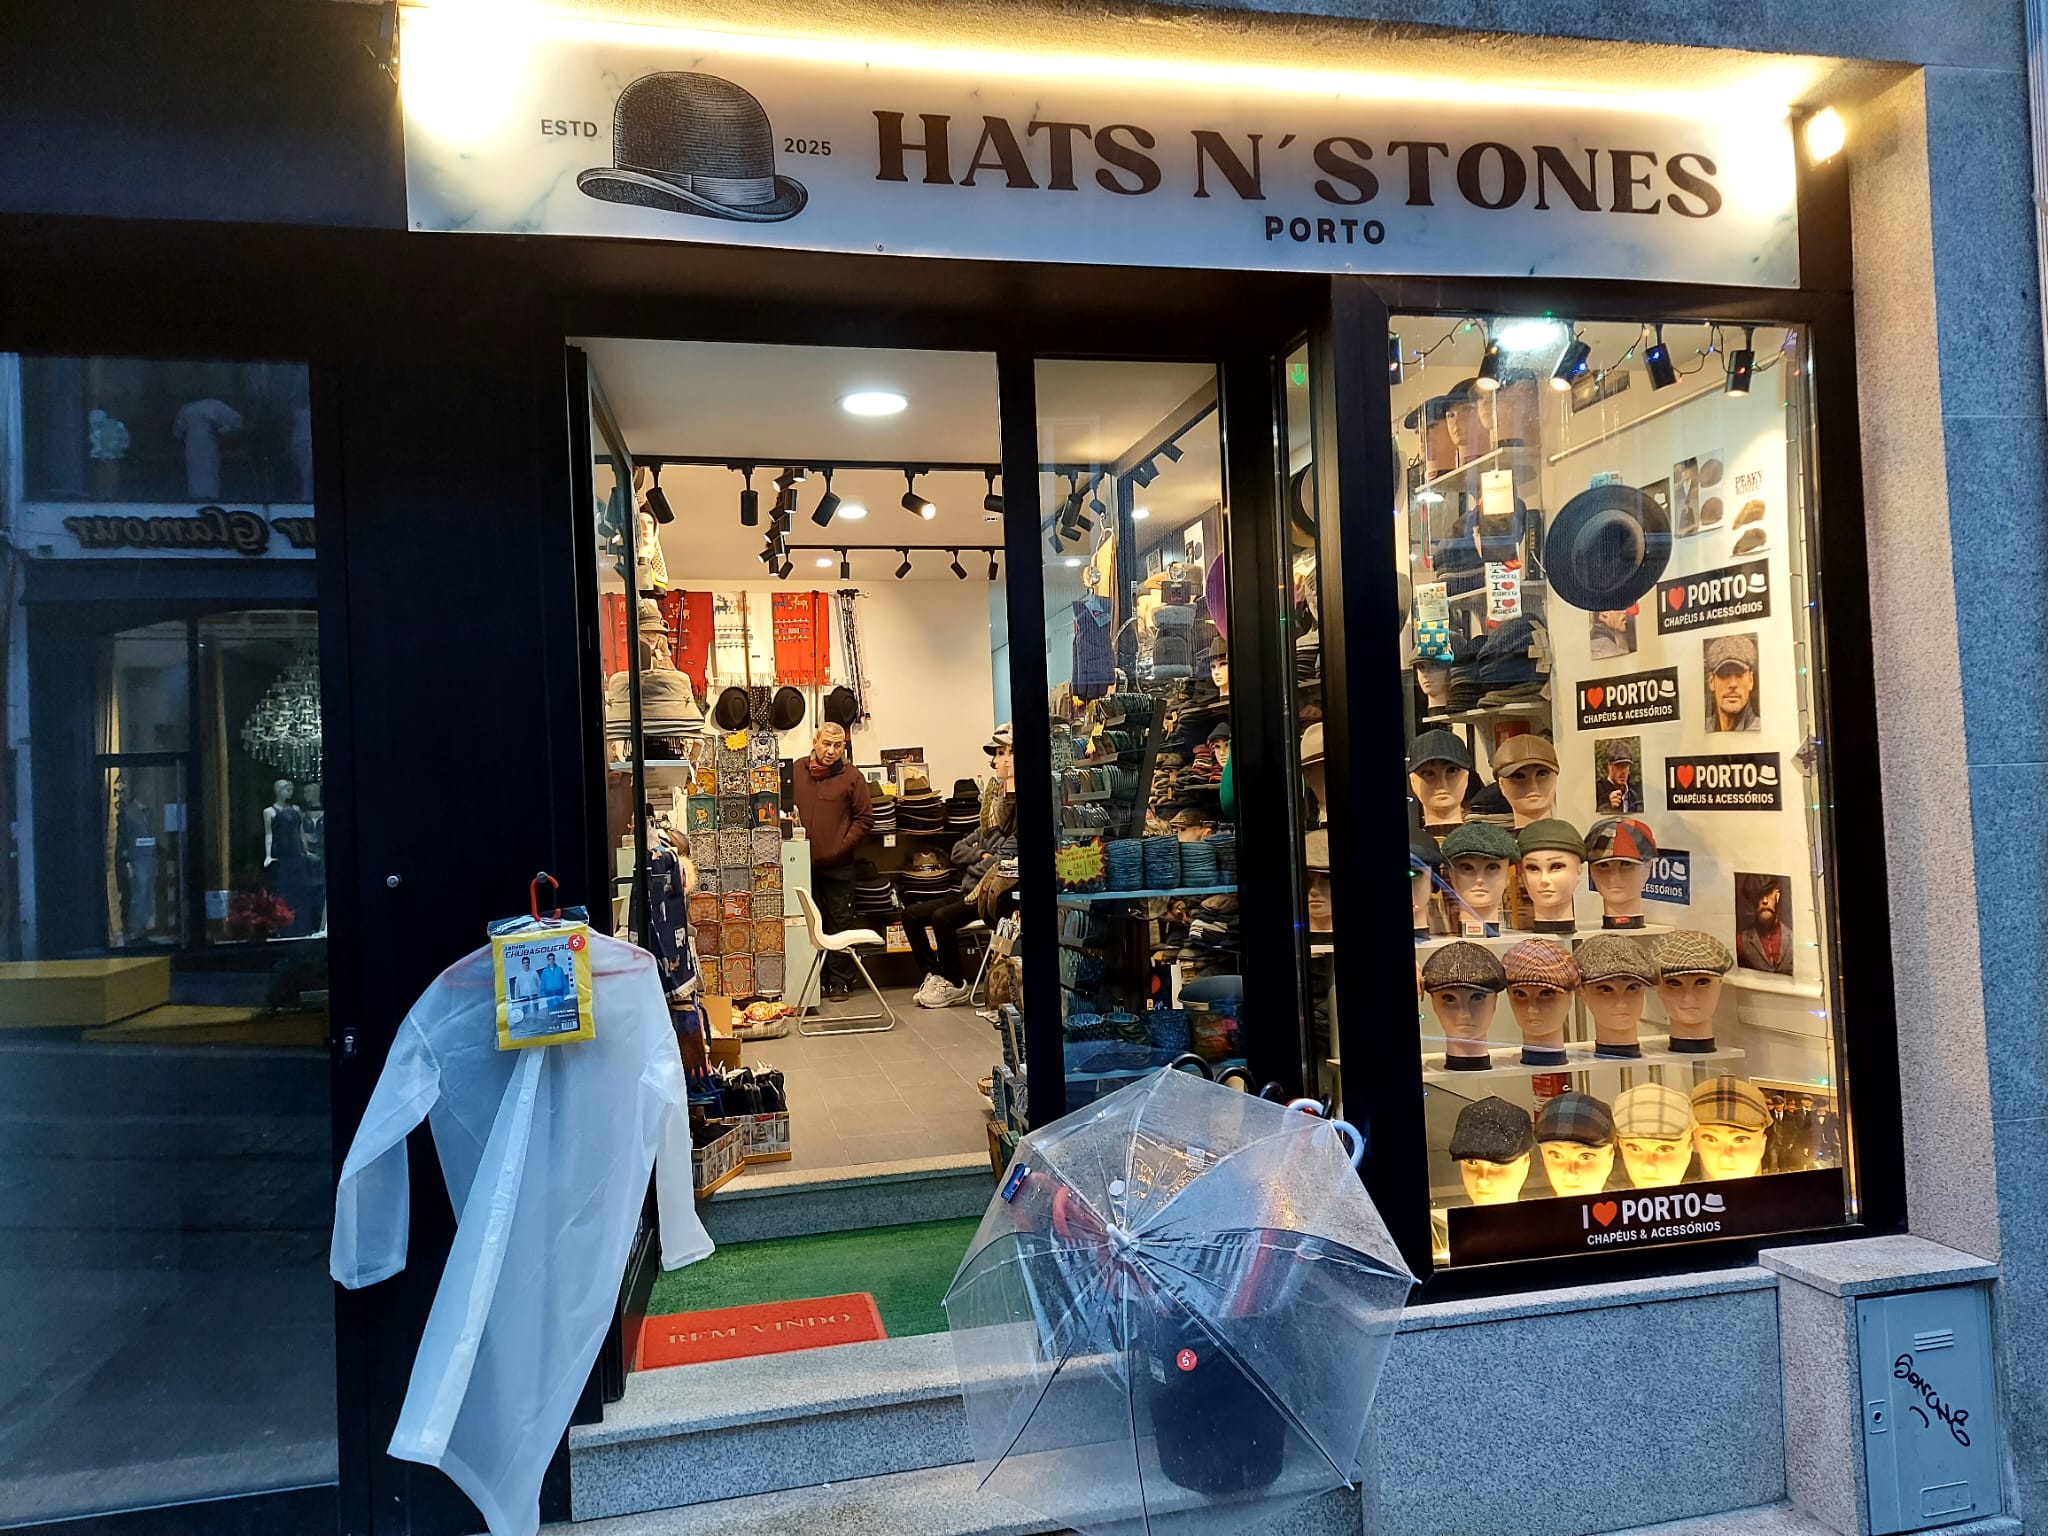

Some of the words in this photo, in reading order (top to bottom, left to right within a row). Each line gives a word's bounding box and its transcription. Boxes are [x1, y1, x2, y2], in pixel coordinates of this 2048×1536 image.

[541, 119, 598, 137] ESTD
[784, 137, 832, 156] 2025
[872, 110, 1162, 196] HATS
[1265, 215, 1386, 245] PORTO
[1661, 591, 1667, 613] I
[1687, 574, 1748, 609] PORTO
[1664, 612, 1698, 628] CHAPÉUS
[1706, 601, 1763, 620] ACESSÓRIOS
[1580, 690, 1585, 711] I
[1606, 679, 1659, 708] PORTO
[1583, 712, 1617, 724] CHAPÉUS
[1625, 705, 1673, 719] ACESSÓRIOS
[1670, 766, 1675, 789] I
[1696, 763, 1757, 788] PORTO
[1673, 793, 1707, 804] CHAPÉUS
[1715, 791, 1774, 804] ACESSÓRIOS
[1582, 1204, 1589, 1229] I
[1622, 1192, 1701, 1225] PORTO
[1587, 1230, 1638, 1245] CHAPÉUS
[1639, 1229, 1648, 1239] &
[1651, 1221, 1721, 1239] ACESSÓRIOS
